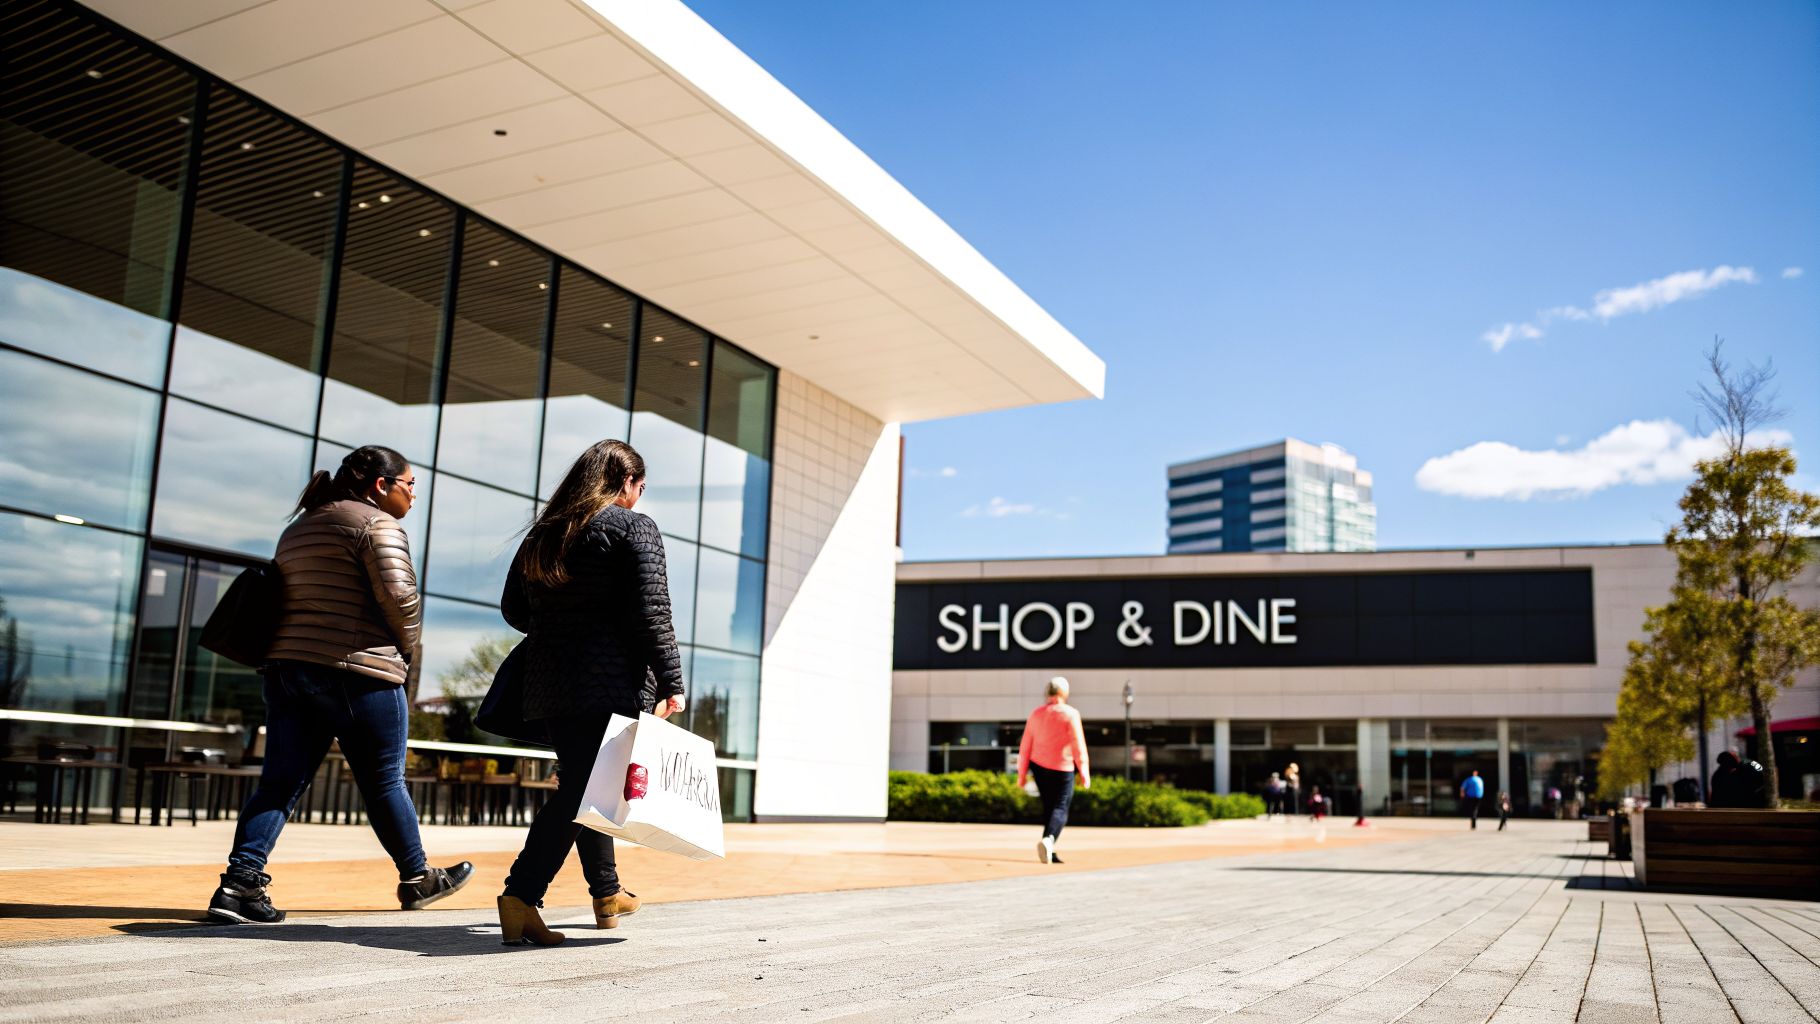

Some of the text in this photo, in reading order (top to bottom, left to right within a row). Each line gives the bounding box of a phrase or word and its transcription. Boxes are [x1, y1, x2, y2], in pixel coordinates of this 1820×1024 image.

[936, 598, 1298, 653] SHOP & DINE
